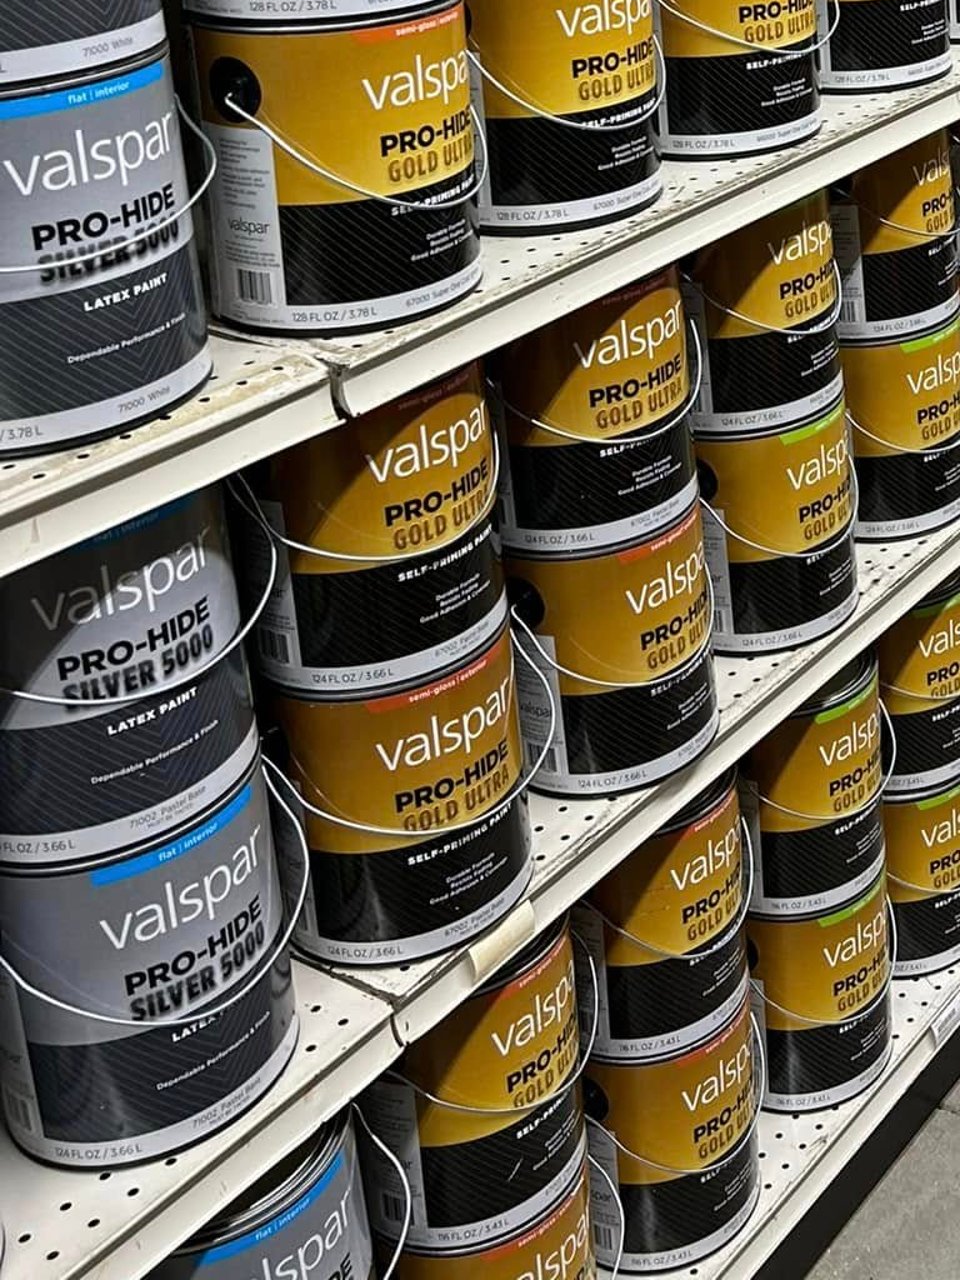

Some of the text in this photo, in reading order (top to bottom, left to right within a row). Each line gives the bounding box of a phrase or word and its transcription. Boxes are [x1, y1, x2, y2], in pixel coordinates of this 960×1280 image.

[250, 0, 336, 13] 128 FL OZ 3.78 L
[67, 79, 130, 105] flat interior
[361, 54, 468, 111] valspa
[578, 74, 623, 101] GOLD
[3, 110, 172, 197] valspar
[388, 150, 438, 183] GOLD
[31, 183, 176, 251] PRO-HIDE
[84, 272, 167, 313] LATEX PAINT
[785, 294, 818, 318] GOLD
[309, 311, 321, 322] FL
[323, 309, 339, 320] OZ
[349, 308, 369, 319] 3.78
[371, 307, 377, 316] L
[574, 300, 682, 369] valspar
[67, 324, 165, 364] Dependable Performance
[589, 354, 682, 408] PRO-HIDE
[595, 378, 683, 429] GOLD ULTRA
[8, 427, 31, 440] 3.78
[34, 426, 42, 436] L
[366, 399, 487, 484] valspar
[384, 457, 489, 527] PRO-HIDE
[393, 515, 447, 550] GOLD
[804, 515, 836, 541] GOLD
[31, 524, 211, 632] valspar
[56, 595, 211, 681] PRO-HIDE
[162, 623, 214, 675] 5000
[646, 638, 686, 670] GOLD
[329, 673, 340, 683] FL
[342, 672, 356, 682] OZ
[365, 669, 386, 681] 3.66
[409, 679, 456, 703] semi-gloss
[107, 687, 197, 736] LATEX PAINT
[376, 678, 510, 772] valspar
[91, 737, 194, 785] Dependable Performance
[395, 738, 509, 814] PRO-HIDE
[403, 765, 511, 831] GOLD ULTRA
[3, 842, 15, 852] FL
[17, 843, 32, 853] OZ
[44, 841, 65, 852] 3.66
[158, 823, 218, 862] flat interior
[407, 824, 488, 866] SELF-PRIMING
[100, 824, 261, 950] valspar
[124, 895, 262, 996] PRO-HIDE
[688, 910, 722, 941] GOLD
[130, 926, 265, 1022] SILVER 5000
[838, 984, 871, 1013] GOLD
[156, 1034, 249, 1092] Dependable Performance
[71, 1147, 82, 1159] FL
[84, 1147, 100, 1160] OZ
[111, 1146, 133, 1158] 3.66
[699, 1127, 734, 1160] GOLD
